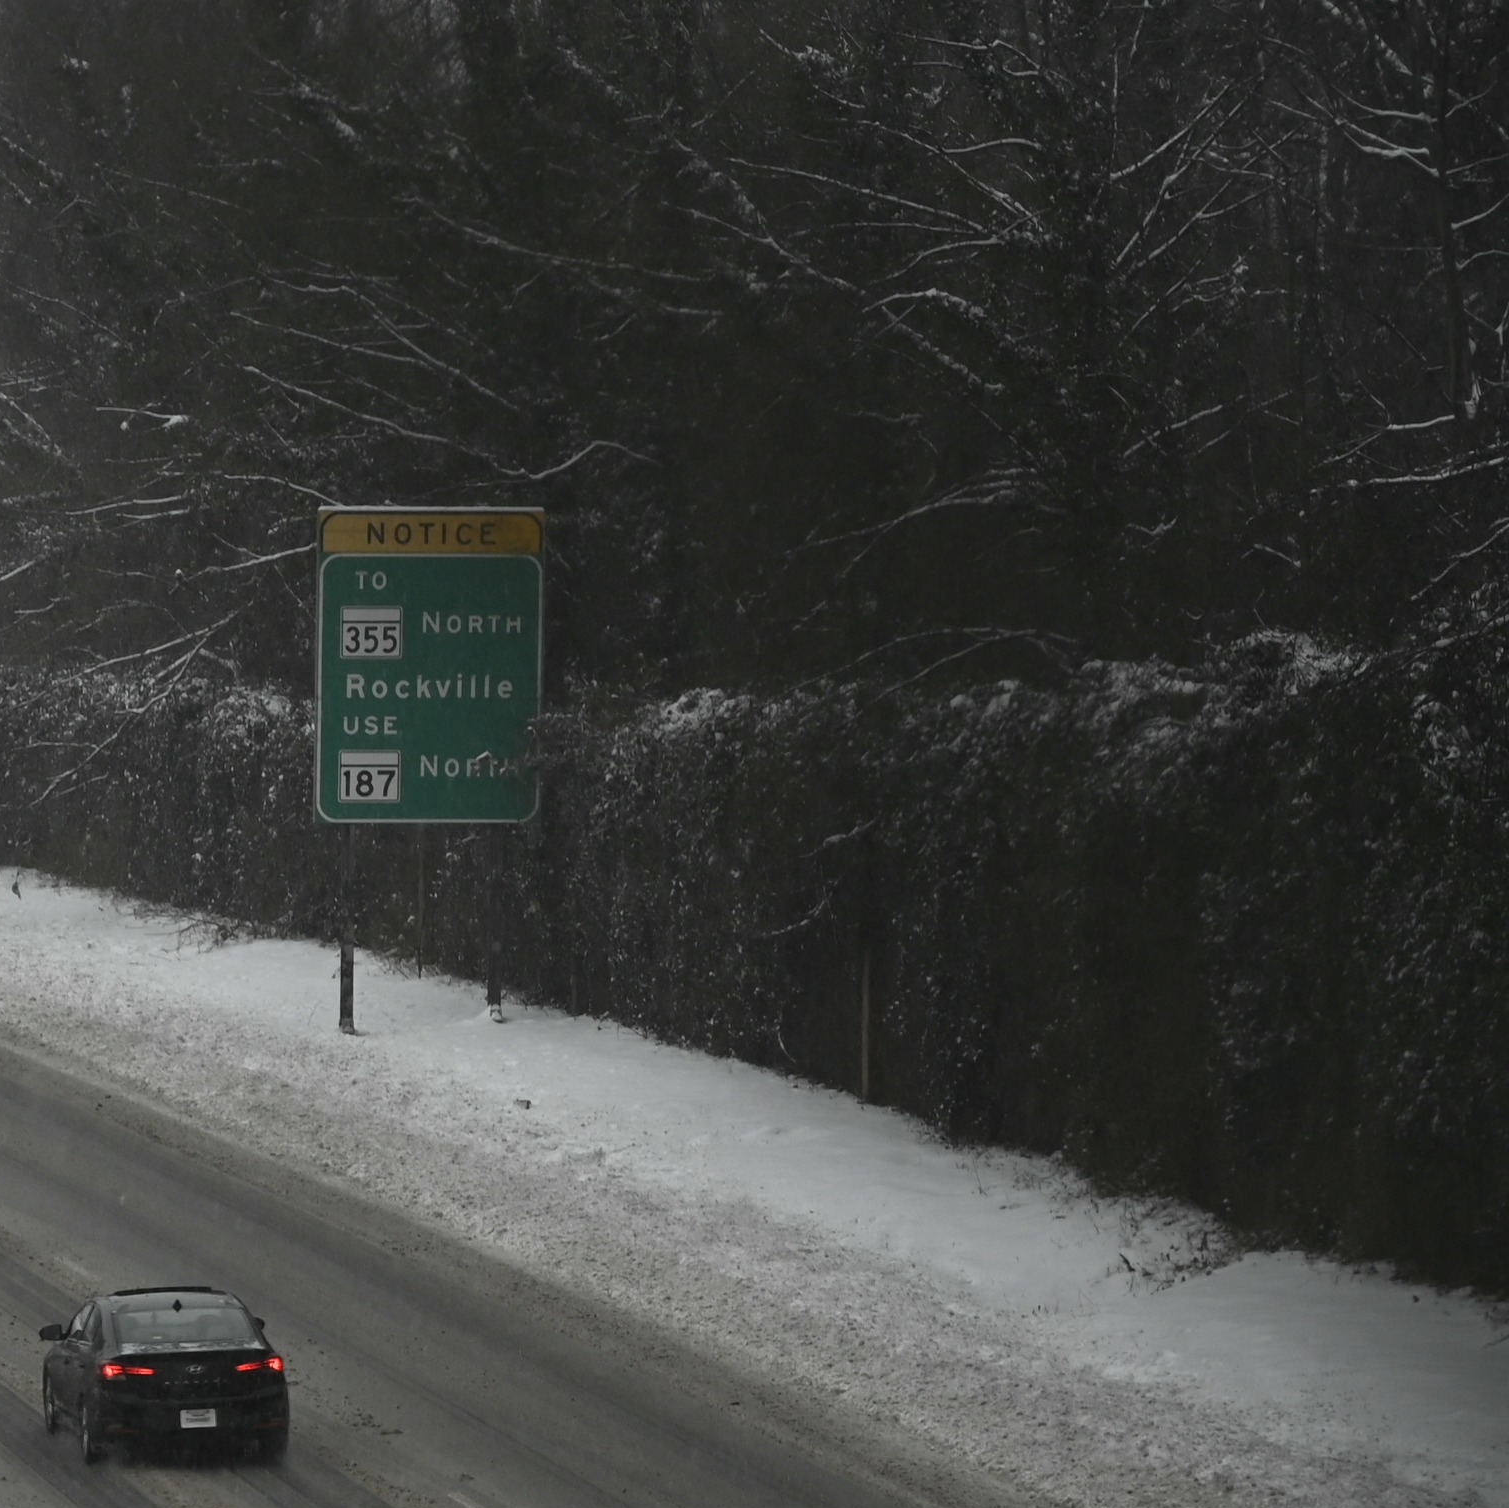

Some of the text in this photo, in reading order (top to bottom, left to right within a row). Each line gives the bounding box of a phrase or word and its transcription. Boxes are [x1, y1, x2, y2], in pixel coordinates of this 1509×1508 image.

[366, 522, 497, 546] NOTICE
[355, 571, 388, 590] TO
[345, 625, 398, 654] 355
[345, 673, 513, 699] Rockville
[343, 716, 398, 735] USE
[343, 770, 396, 797] 187
